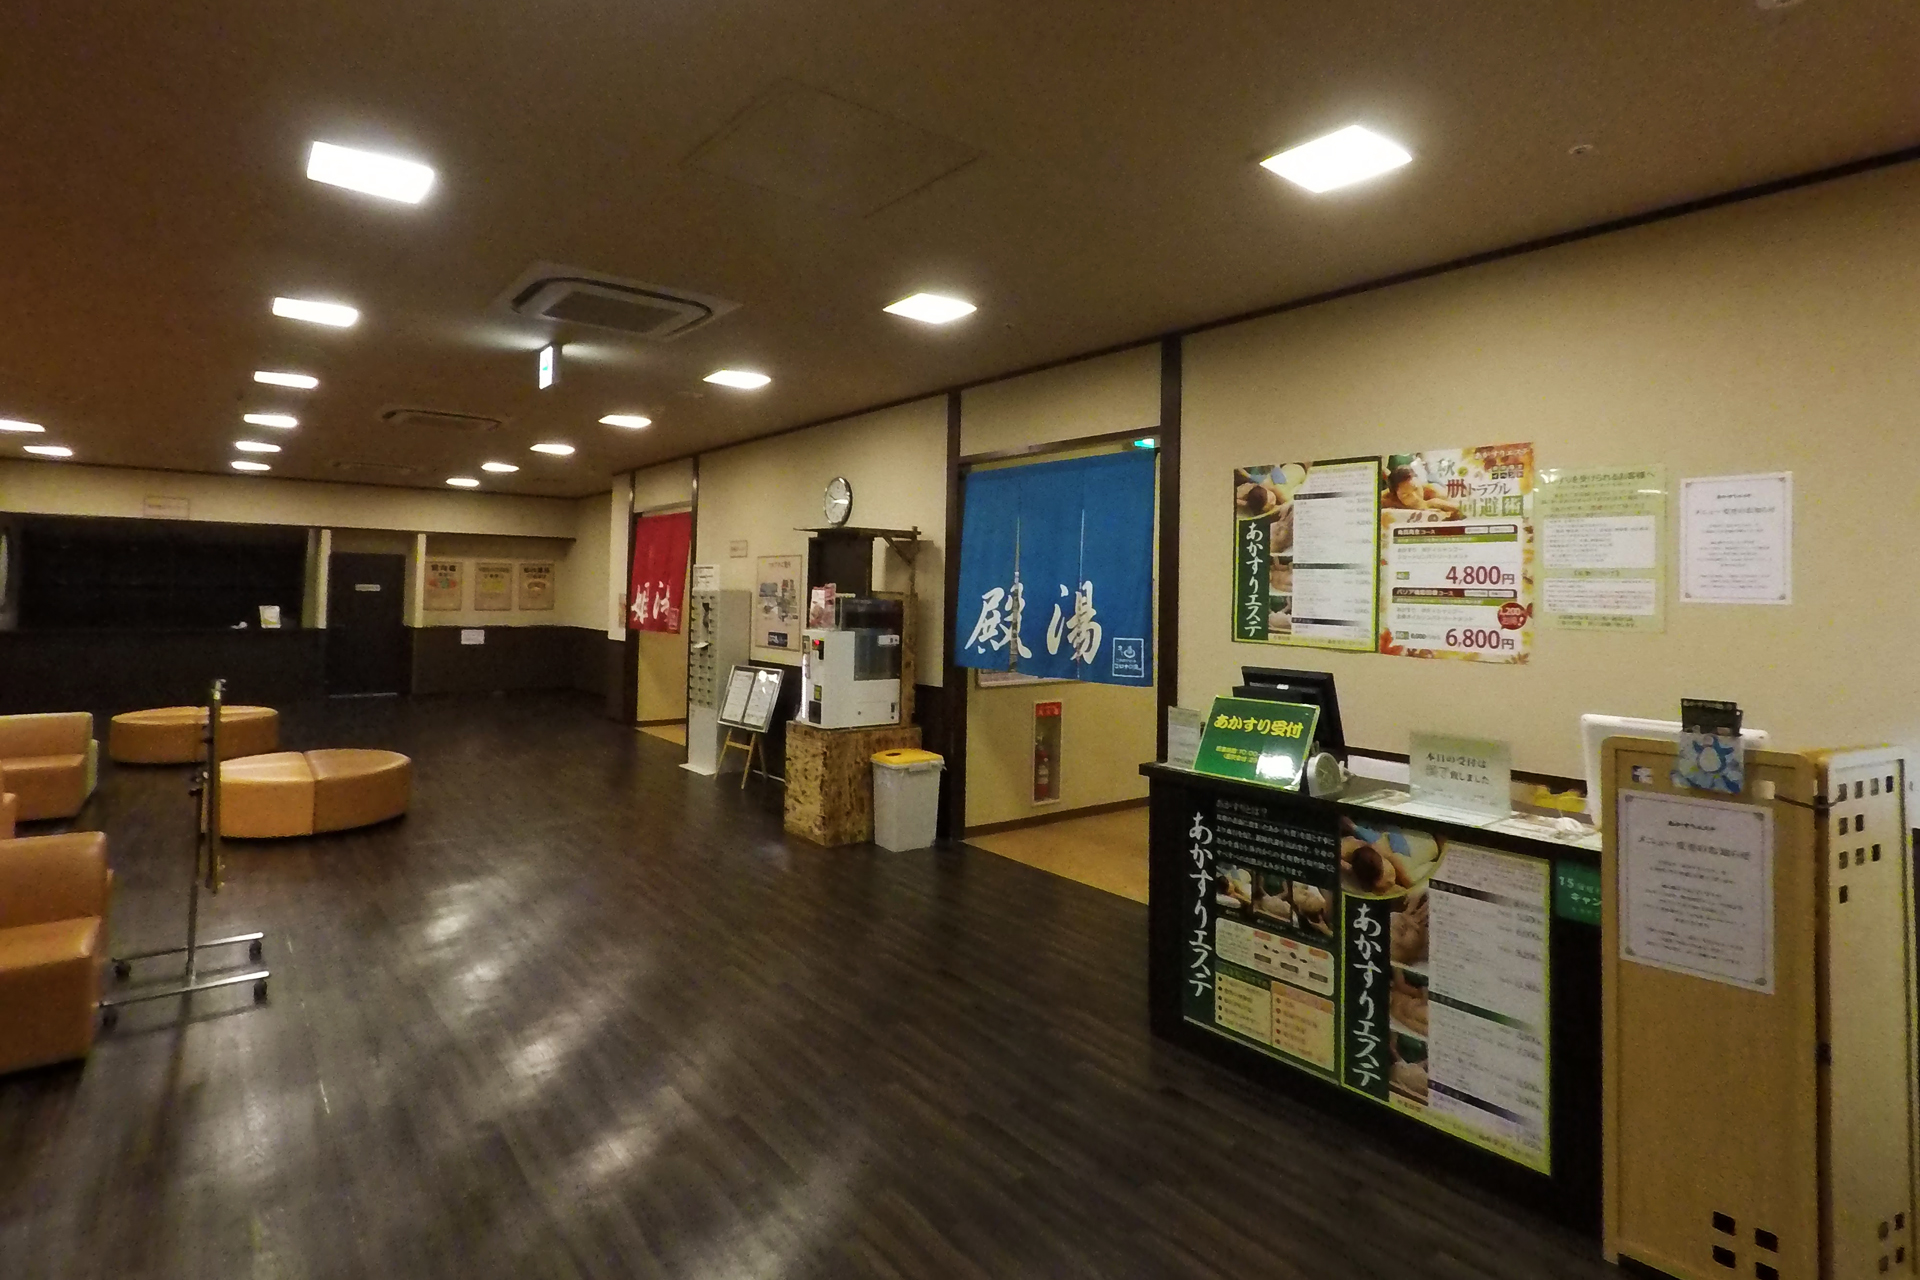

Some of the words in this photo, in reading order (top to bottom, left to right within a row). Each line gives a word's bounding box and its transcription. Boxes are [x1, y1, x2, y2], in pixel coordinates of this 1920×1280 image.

[1244, 521, 1264, 638] あかすりエステ
[1445, 565, 1516, 586] 4,800円
[1445, 628, 1516, 650] 6,800円
[1213, 713, 1304, 739] あかすり受付
[1425, 752, 1487, 769] 本日の受付は
[1188, 811, 1213, 997] あかすりエステ
[1353, 902, 1382, 1088] あかすりエステ
